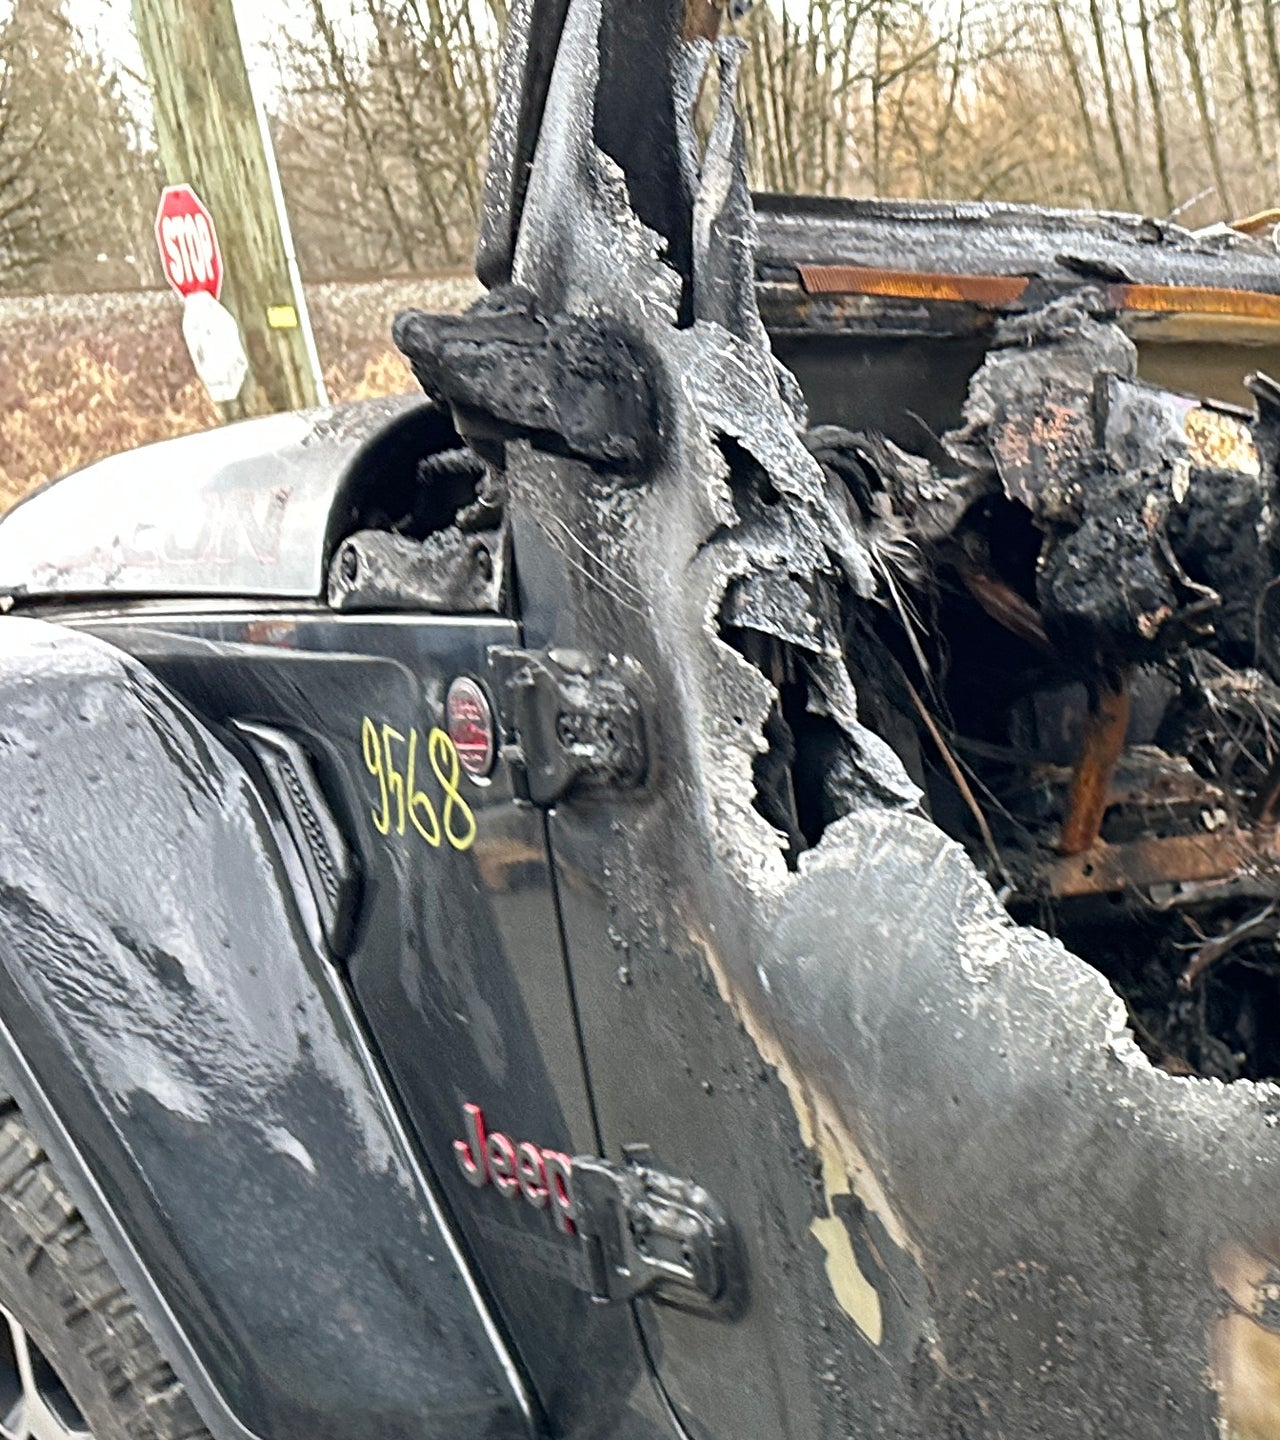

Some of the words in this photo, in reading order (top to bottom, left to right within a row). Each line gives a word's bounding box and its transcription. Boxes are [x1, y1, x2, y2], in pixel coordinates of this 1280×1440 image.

[162, 213, 215, 285] STOP
[361, 715, 477, 850] 9568
[452, 1102, 577, 1236] Jeep
